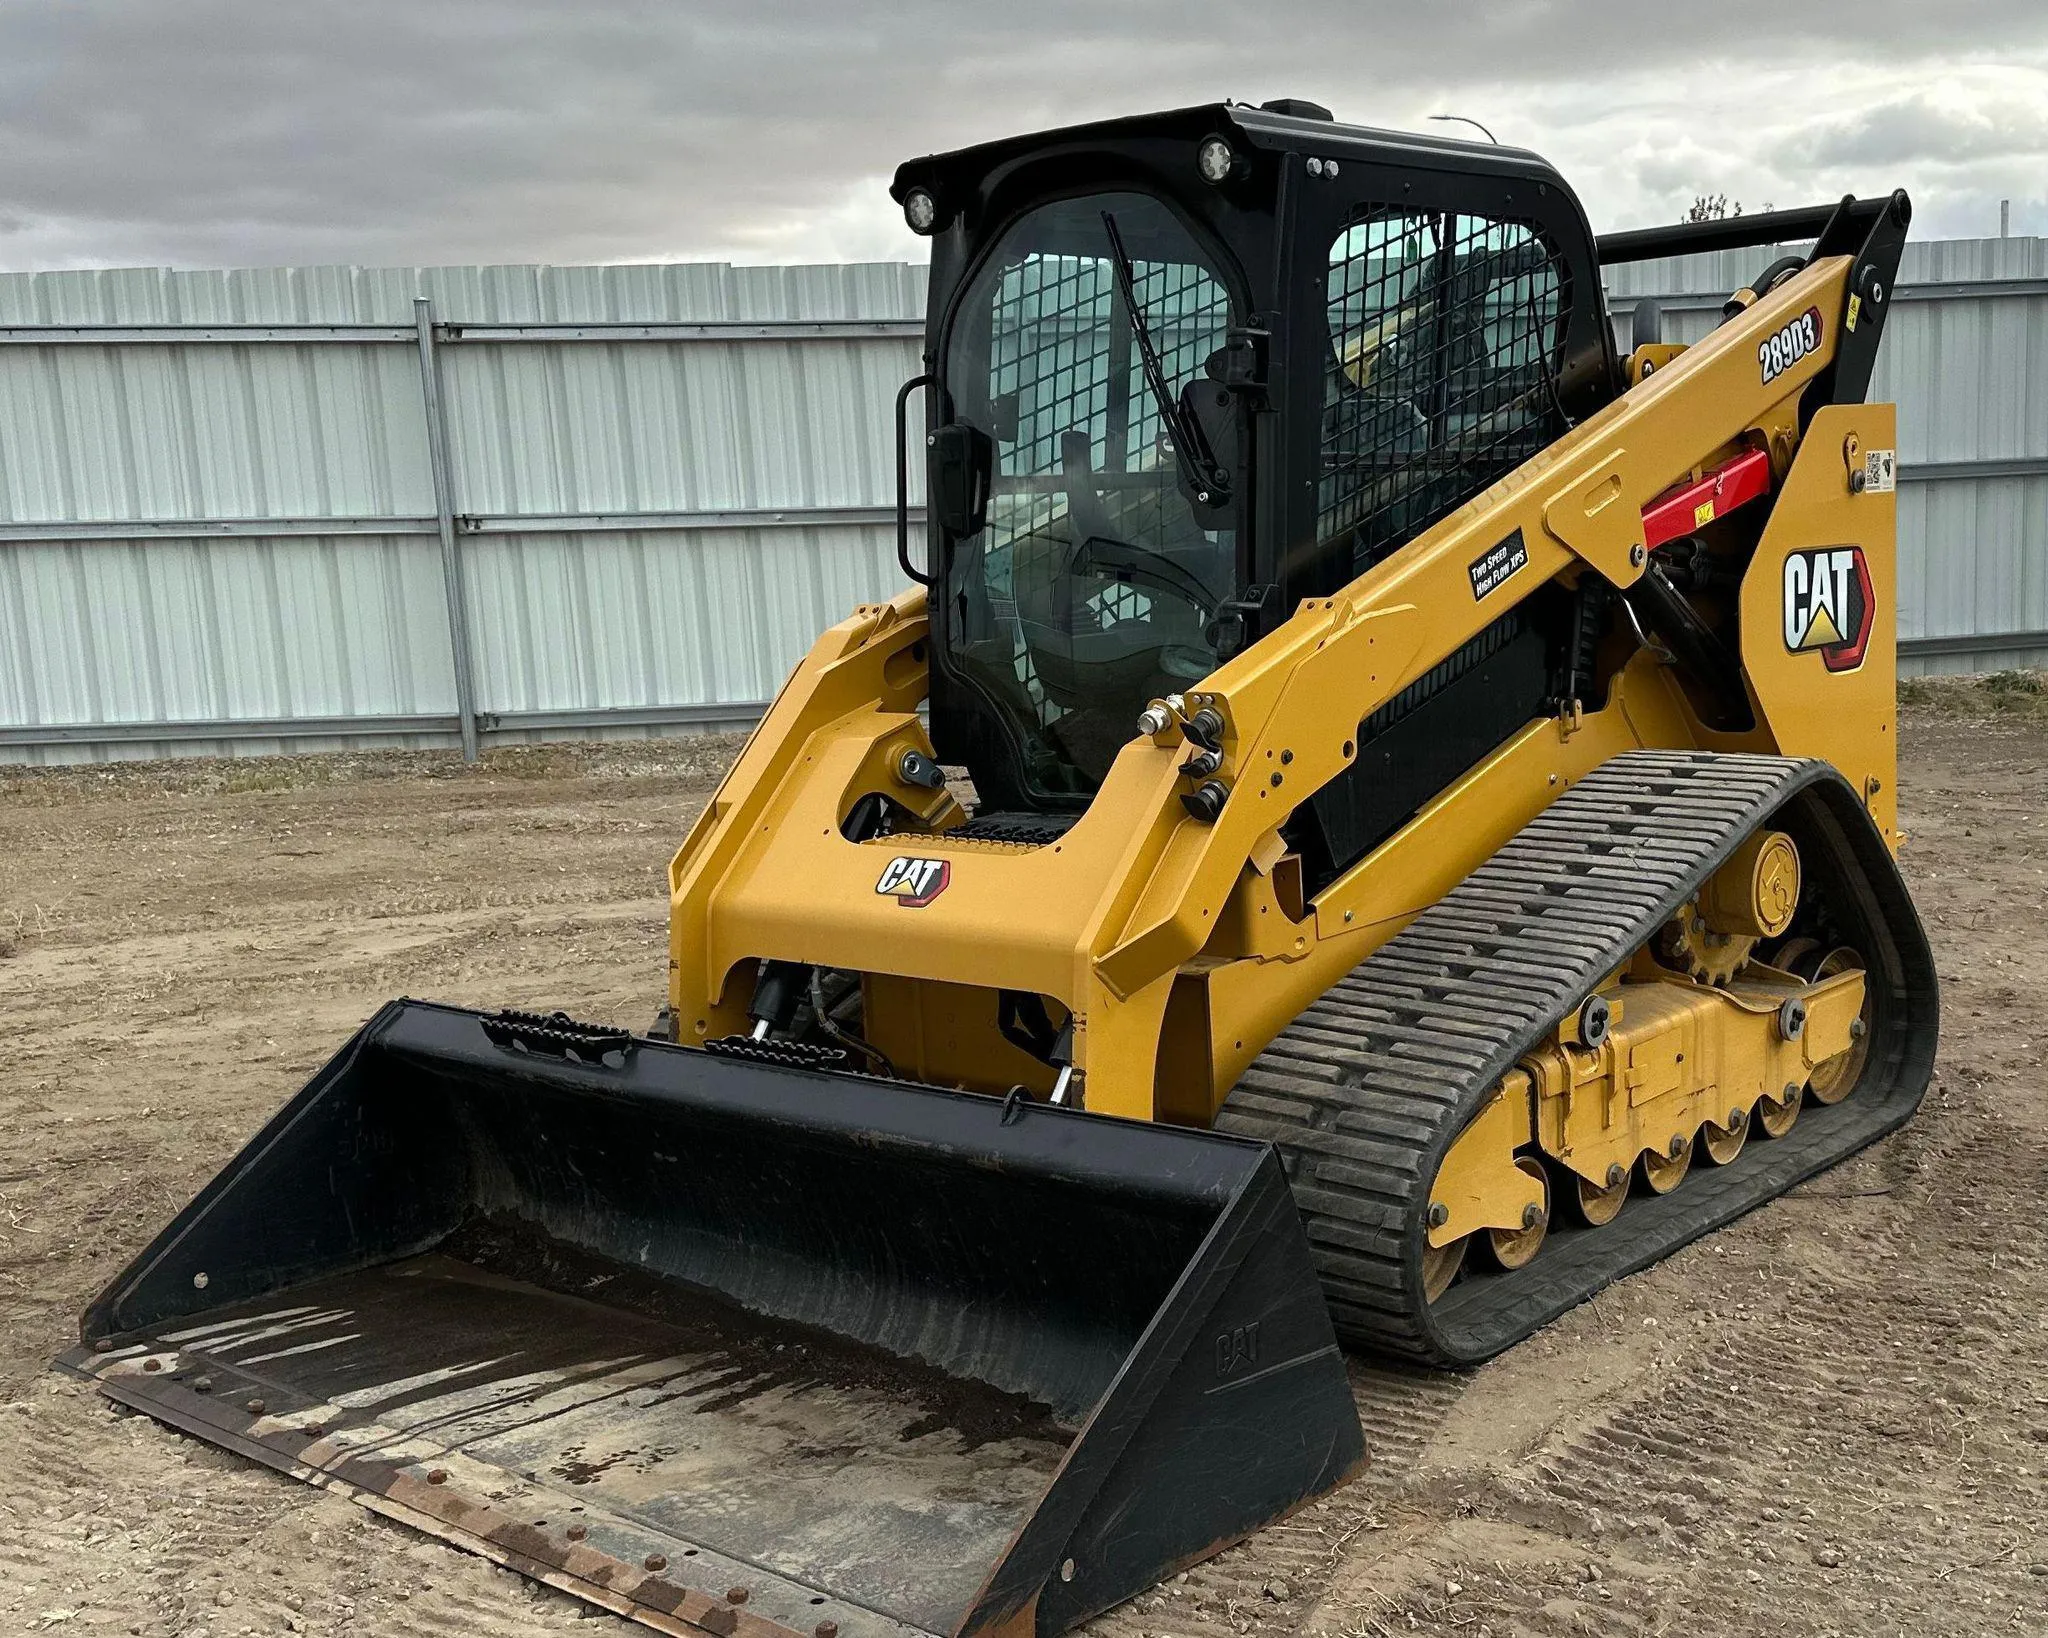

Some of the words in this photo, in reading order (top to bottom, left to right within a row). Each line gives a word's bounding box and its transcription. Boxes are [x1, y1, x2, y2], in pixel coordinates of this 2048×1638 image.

[1759, 313, 1815, 383] 289D3
[1509, 549, 1525, 571] XPS
[1784, 550, 1854, 649] CAT
[876, 857, 944, 897] CAT
[1216, 1321, 1260, 1378] CAT
